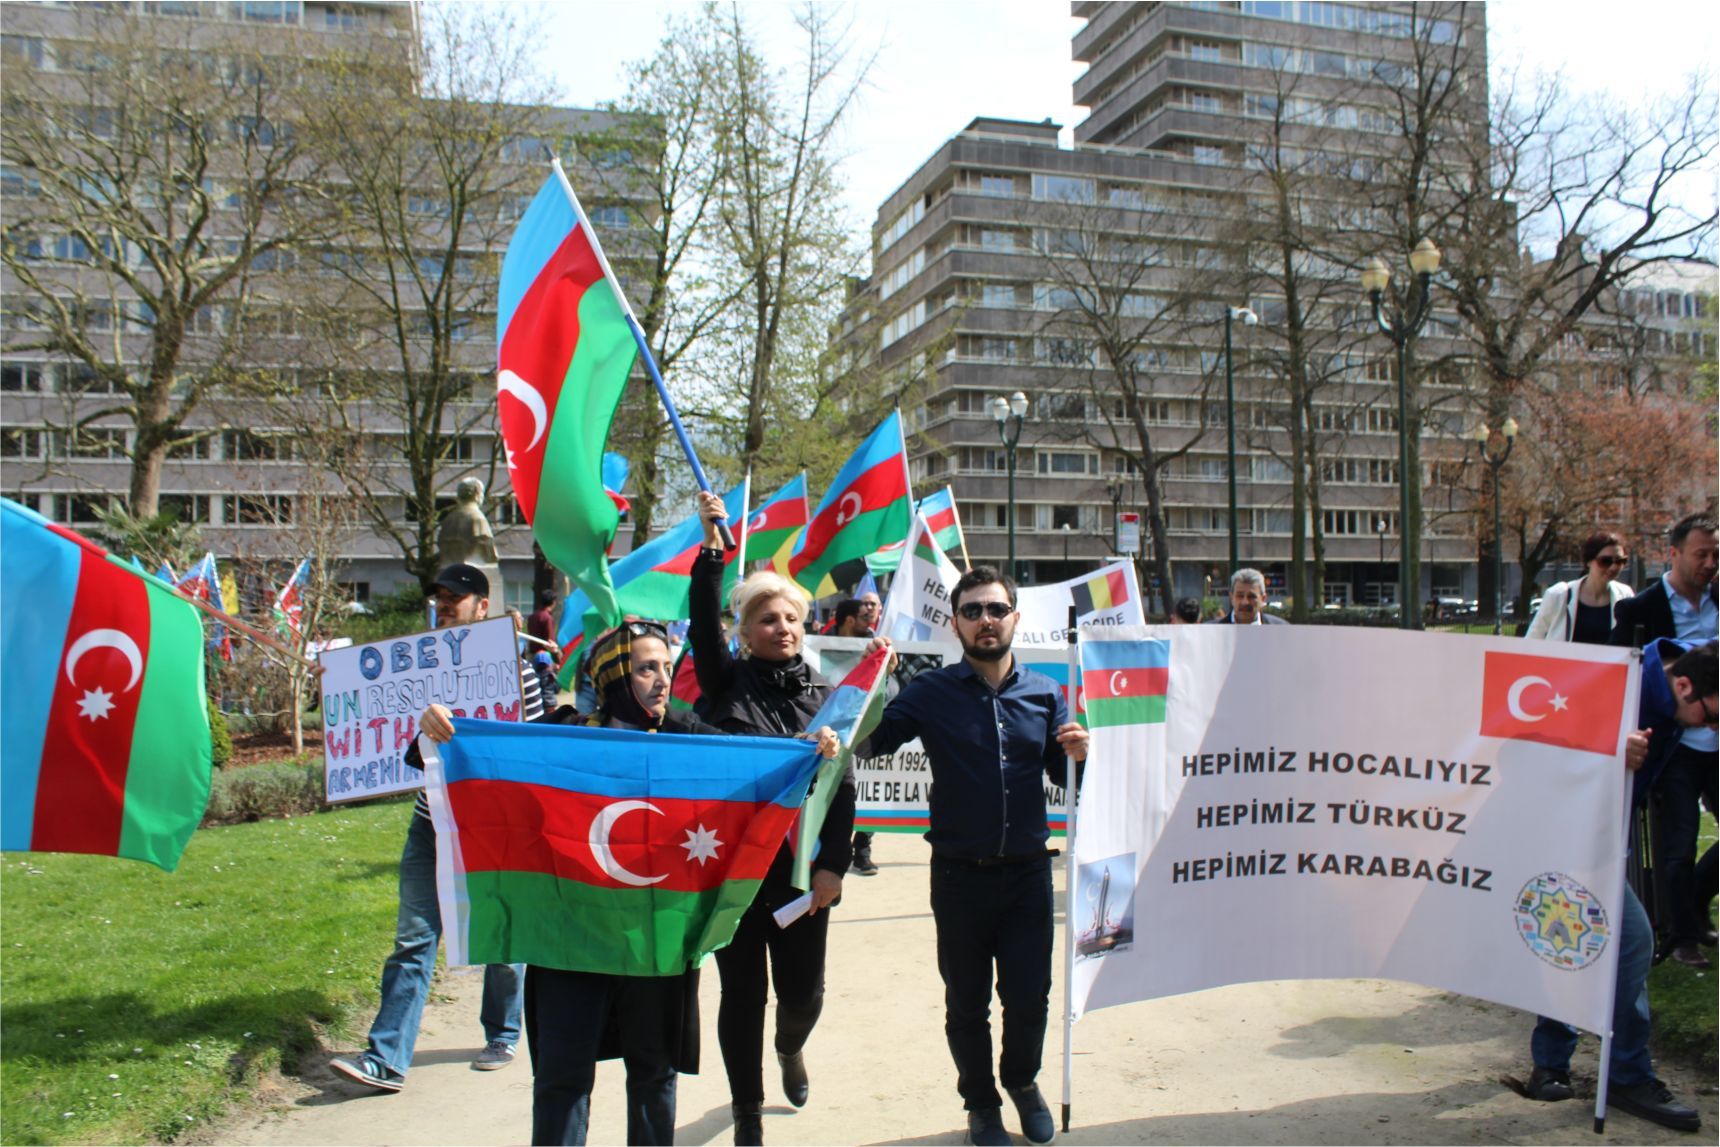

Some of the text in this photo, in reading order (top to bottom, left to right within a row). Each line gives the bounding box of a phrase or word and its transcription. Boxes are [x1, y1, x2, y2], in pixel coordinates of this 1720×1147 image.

[1050, 612, 1126, 642] GECIDE
[359, 628, 471, 681] OBEY
[324, 689, 362, 727] UN
[899, 751, 927, 772] 1992
[1182, 746, 1492, 786] HEPİMİZ HOCALIYIZ
[884, 781, 901, 802] DE
[904, 782, 920, 802] LA
[1197, 797, 1467, 835] HEPİMİZ TÜRKÜZ
[1172, 849, 1493, 892] HEPİMİZ KARABAĞIZ
